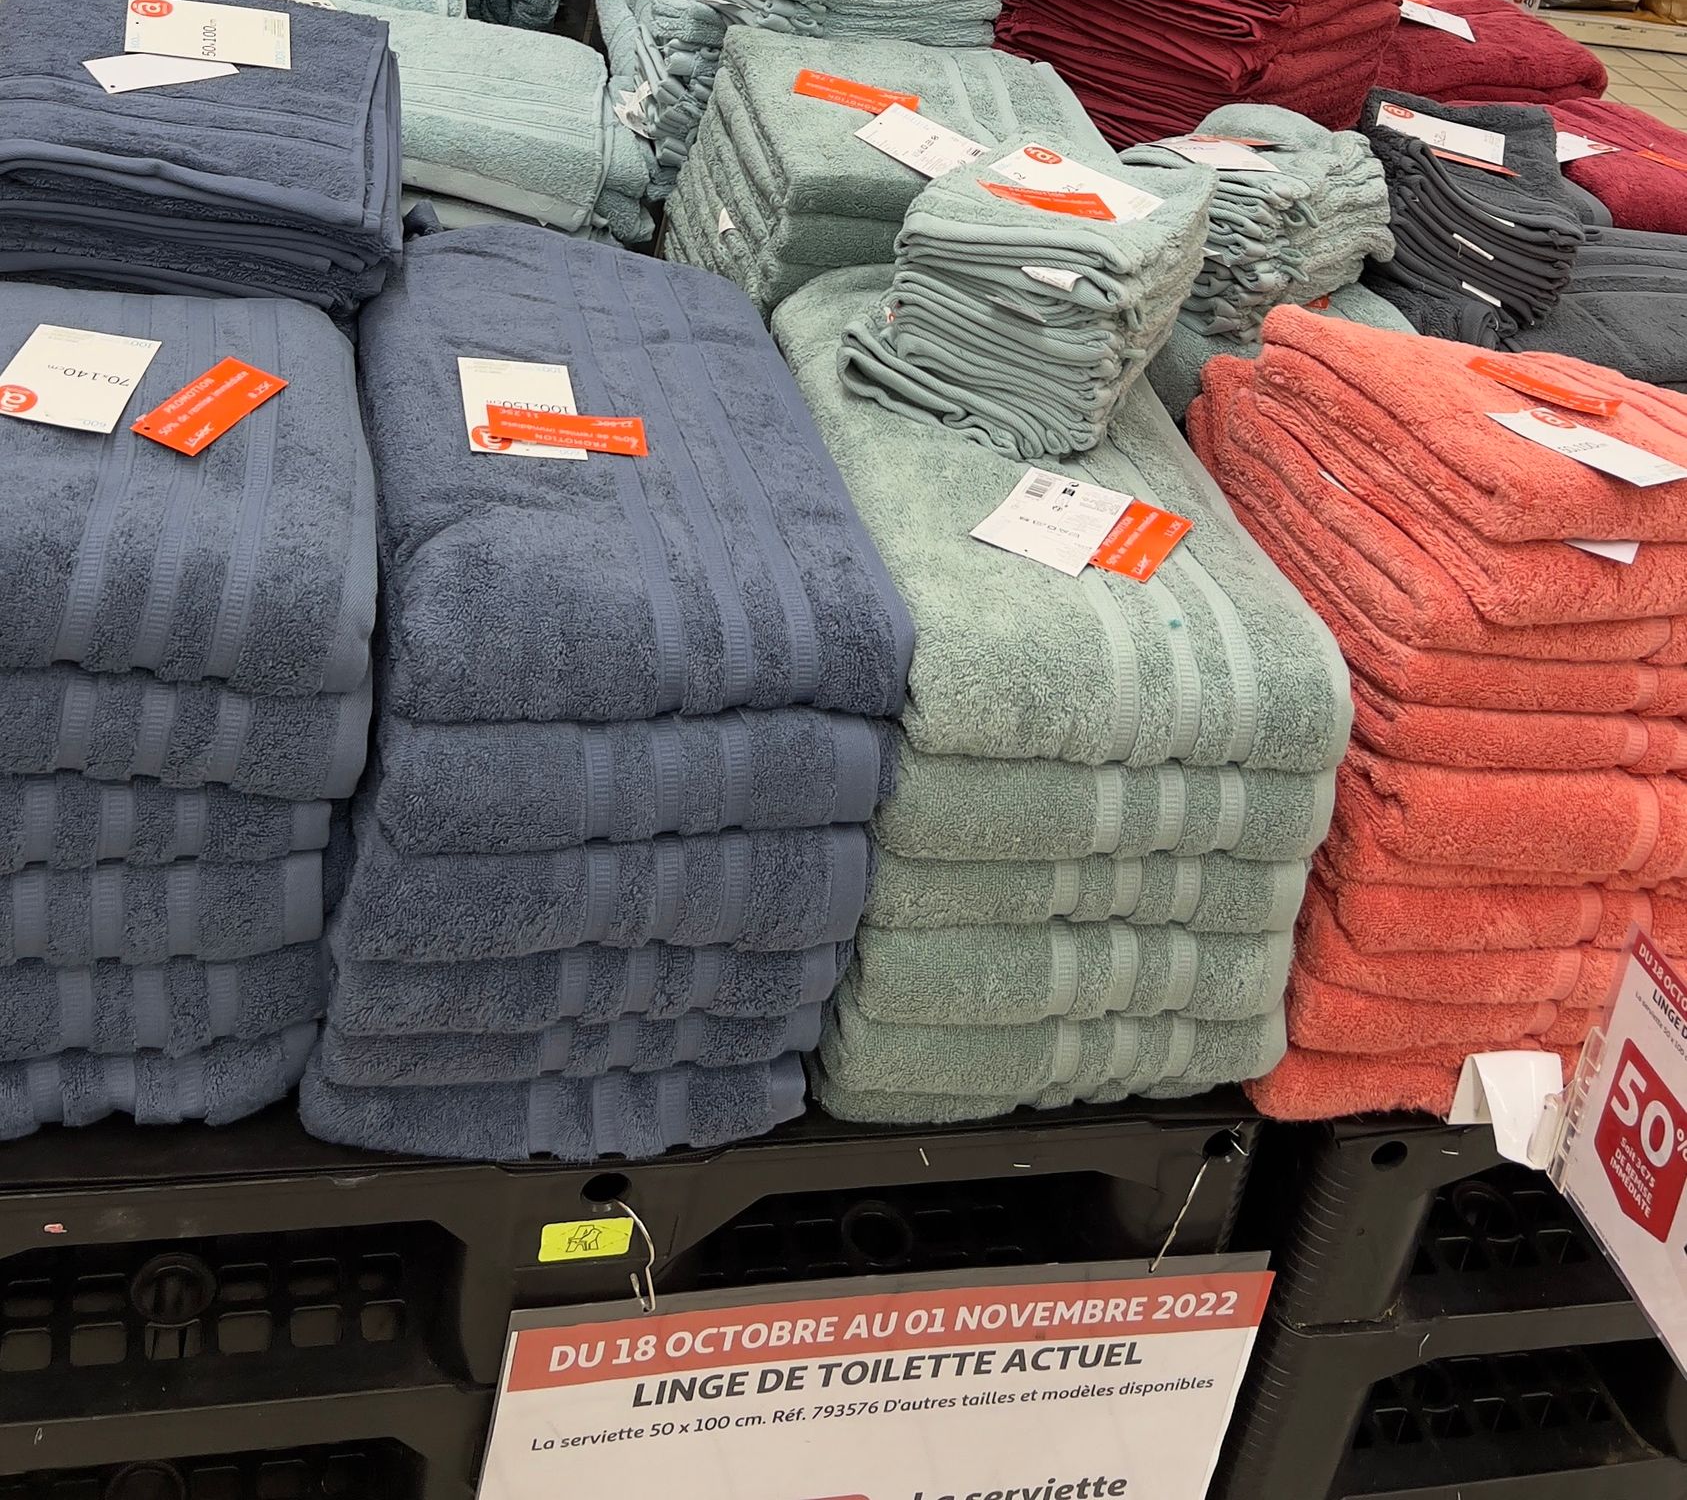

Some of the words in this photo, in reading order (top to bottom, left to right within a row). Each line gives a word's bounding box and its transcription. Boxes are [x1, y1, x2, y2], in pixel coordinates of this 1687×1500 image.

[166, 377, 215, 414] PROMOTION
[1639, 943, 1654, 966] DU
[1652, 962, 1665, 980] 18
[1652, 989, 1682, 1031] LINGE
[1620, 1136, 1637, 1162] Soit
[1614, 1147, 1626, 1166] DE
[1624, 1161, 1653, 1205] REMISE
[548, 1340, 605, 1373] DU
[612, 1334, 657, 1365] 18
[665, 1316, 839, 1358] OCTOBRE
[843, 1310, 899, 1340] AU
[904, 1307, 946, 1335] 01
[954, 1295, 1148, 1332] NOVEMBRE
[1152, 1290, 1239, 1321] 2022
[632, 1371, 750, 1408] LINGE
[757, 1365, 809, 1394] DE
[817, 1349, 997, 1389] TOILETTE
[1001, 1341, 1143, 1374] ACTUEL
[530, 1437, 554, 1451] La
[561, 1426, 644, 1449] serviette
[650, 1422, 674, 1437] 50
[678, 1422, 690, 1434] x
[694, 1415, 730, 1433] 100
[735, 1414, 767, 1428] cm.
[772, 1409, 806, 1424] Réf.
[811, 1400, 879, 1420] 793576
[882, 1394, 957, 1413] D'autres
[962, 1390, 1016, 1407] tailles
[1020, 1389, 1038, 1402] et
[1041, 1384, 1114, 1401] modèles
[1119, 1376, 1214, 1398] disponibles
